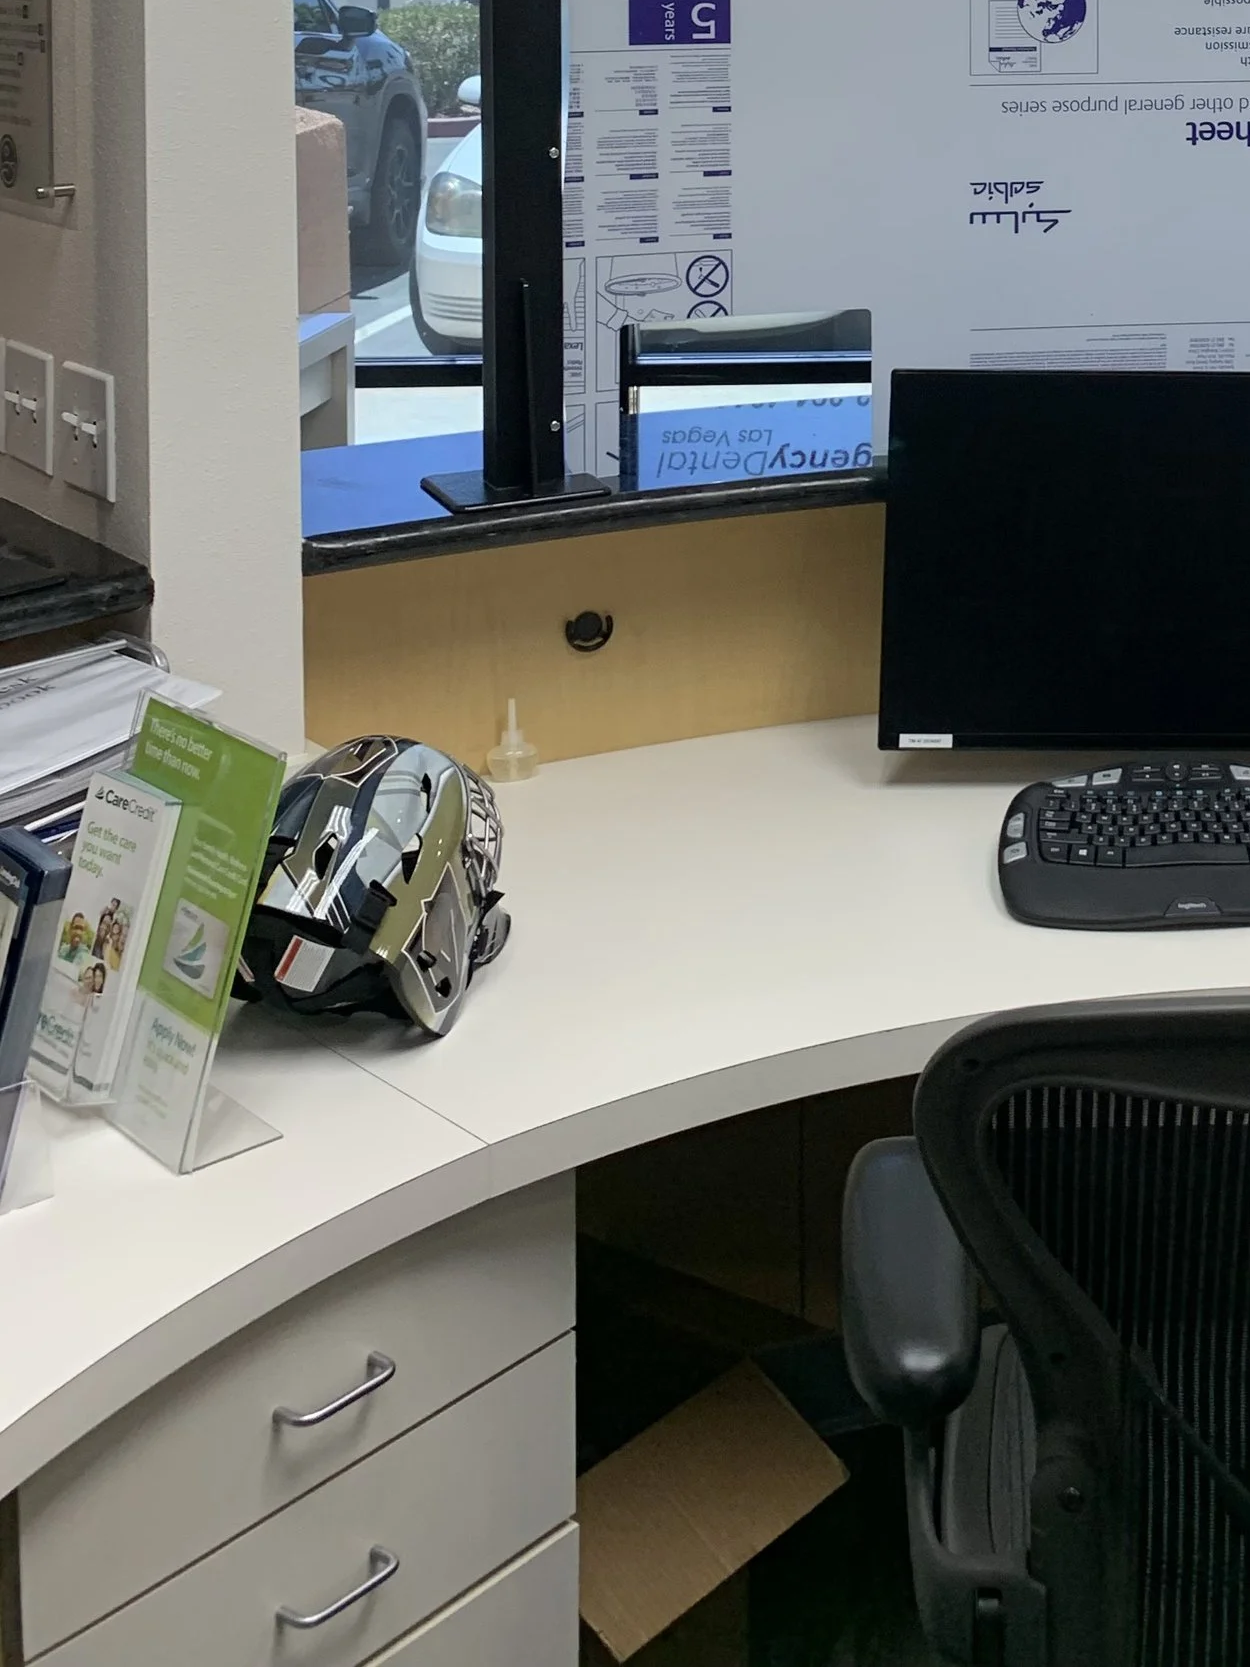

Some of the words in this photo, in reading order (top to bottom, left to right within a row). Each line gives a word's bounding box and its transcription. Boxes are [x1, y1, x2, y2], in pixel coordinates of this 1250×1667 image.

[661, 3, 676, 40] years
[691, 3, 716, 39] 5
[1174, 27, 1232, 37] resistance
[1002, 101, 1048, 116] series
[1052, 96, 1119, 112] purpose
[1125, 94, 1185, 115] general
[1190, 98, 1234, 113] other
[662, 426, 730, 447] Vegas
[738, 429, 773, 447] Las
[105, 789, 156, 823] CareCredit
[87, 821, 103, 839] Get
[103, 827, 119, 845] the
[119, 837, 137, 853] care
[80, 840, 99, 855] you
[98, 846, 122, 865] want
